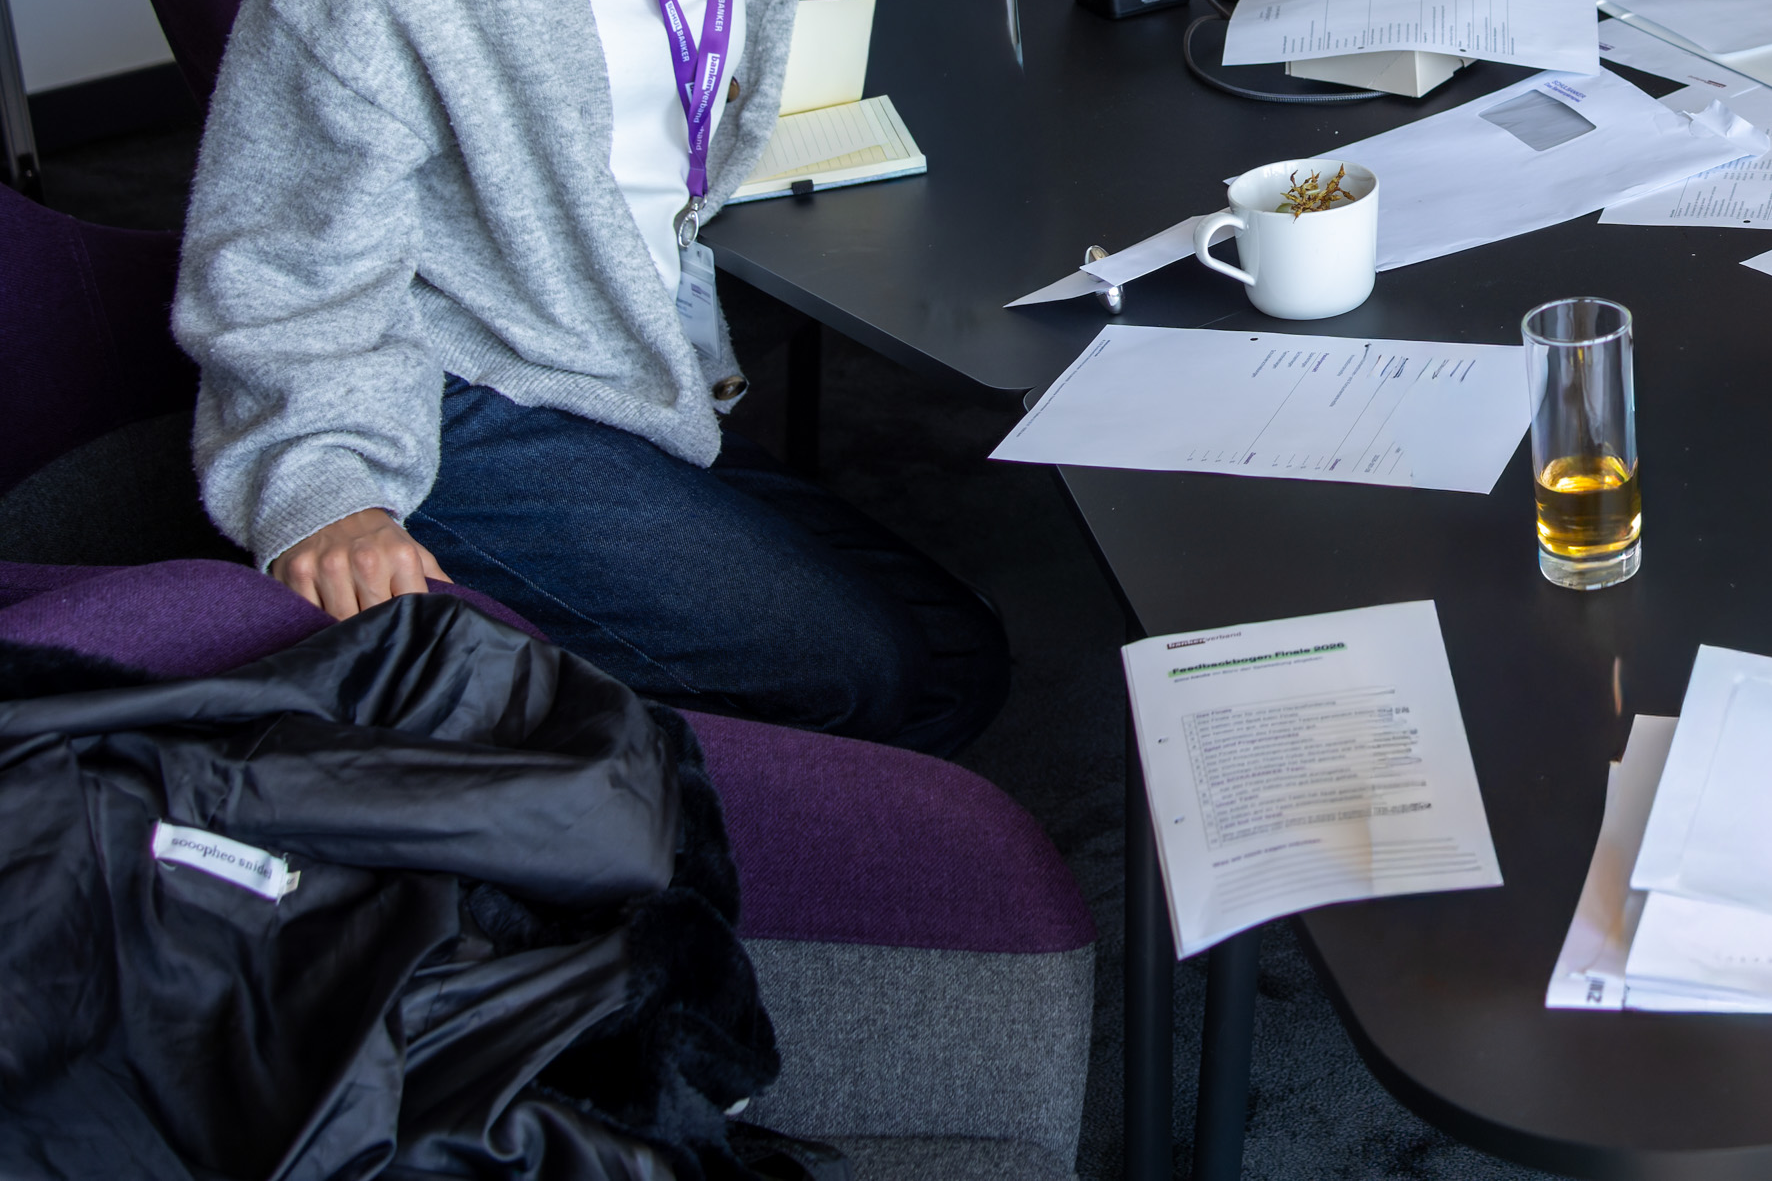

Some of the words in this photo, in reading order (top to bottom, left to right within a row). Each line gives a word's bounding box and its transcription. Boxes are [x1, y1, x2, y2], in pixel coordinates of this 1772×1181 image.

[664, 0, 691, 64] SCHULBANKER
[1171, 650, 1273, 676] Feedbackbogen
[1273, 646, 1312, 660] Finale
